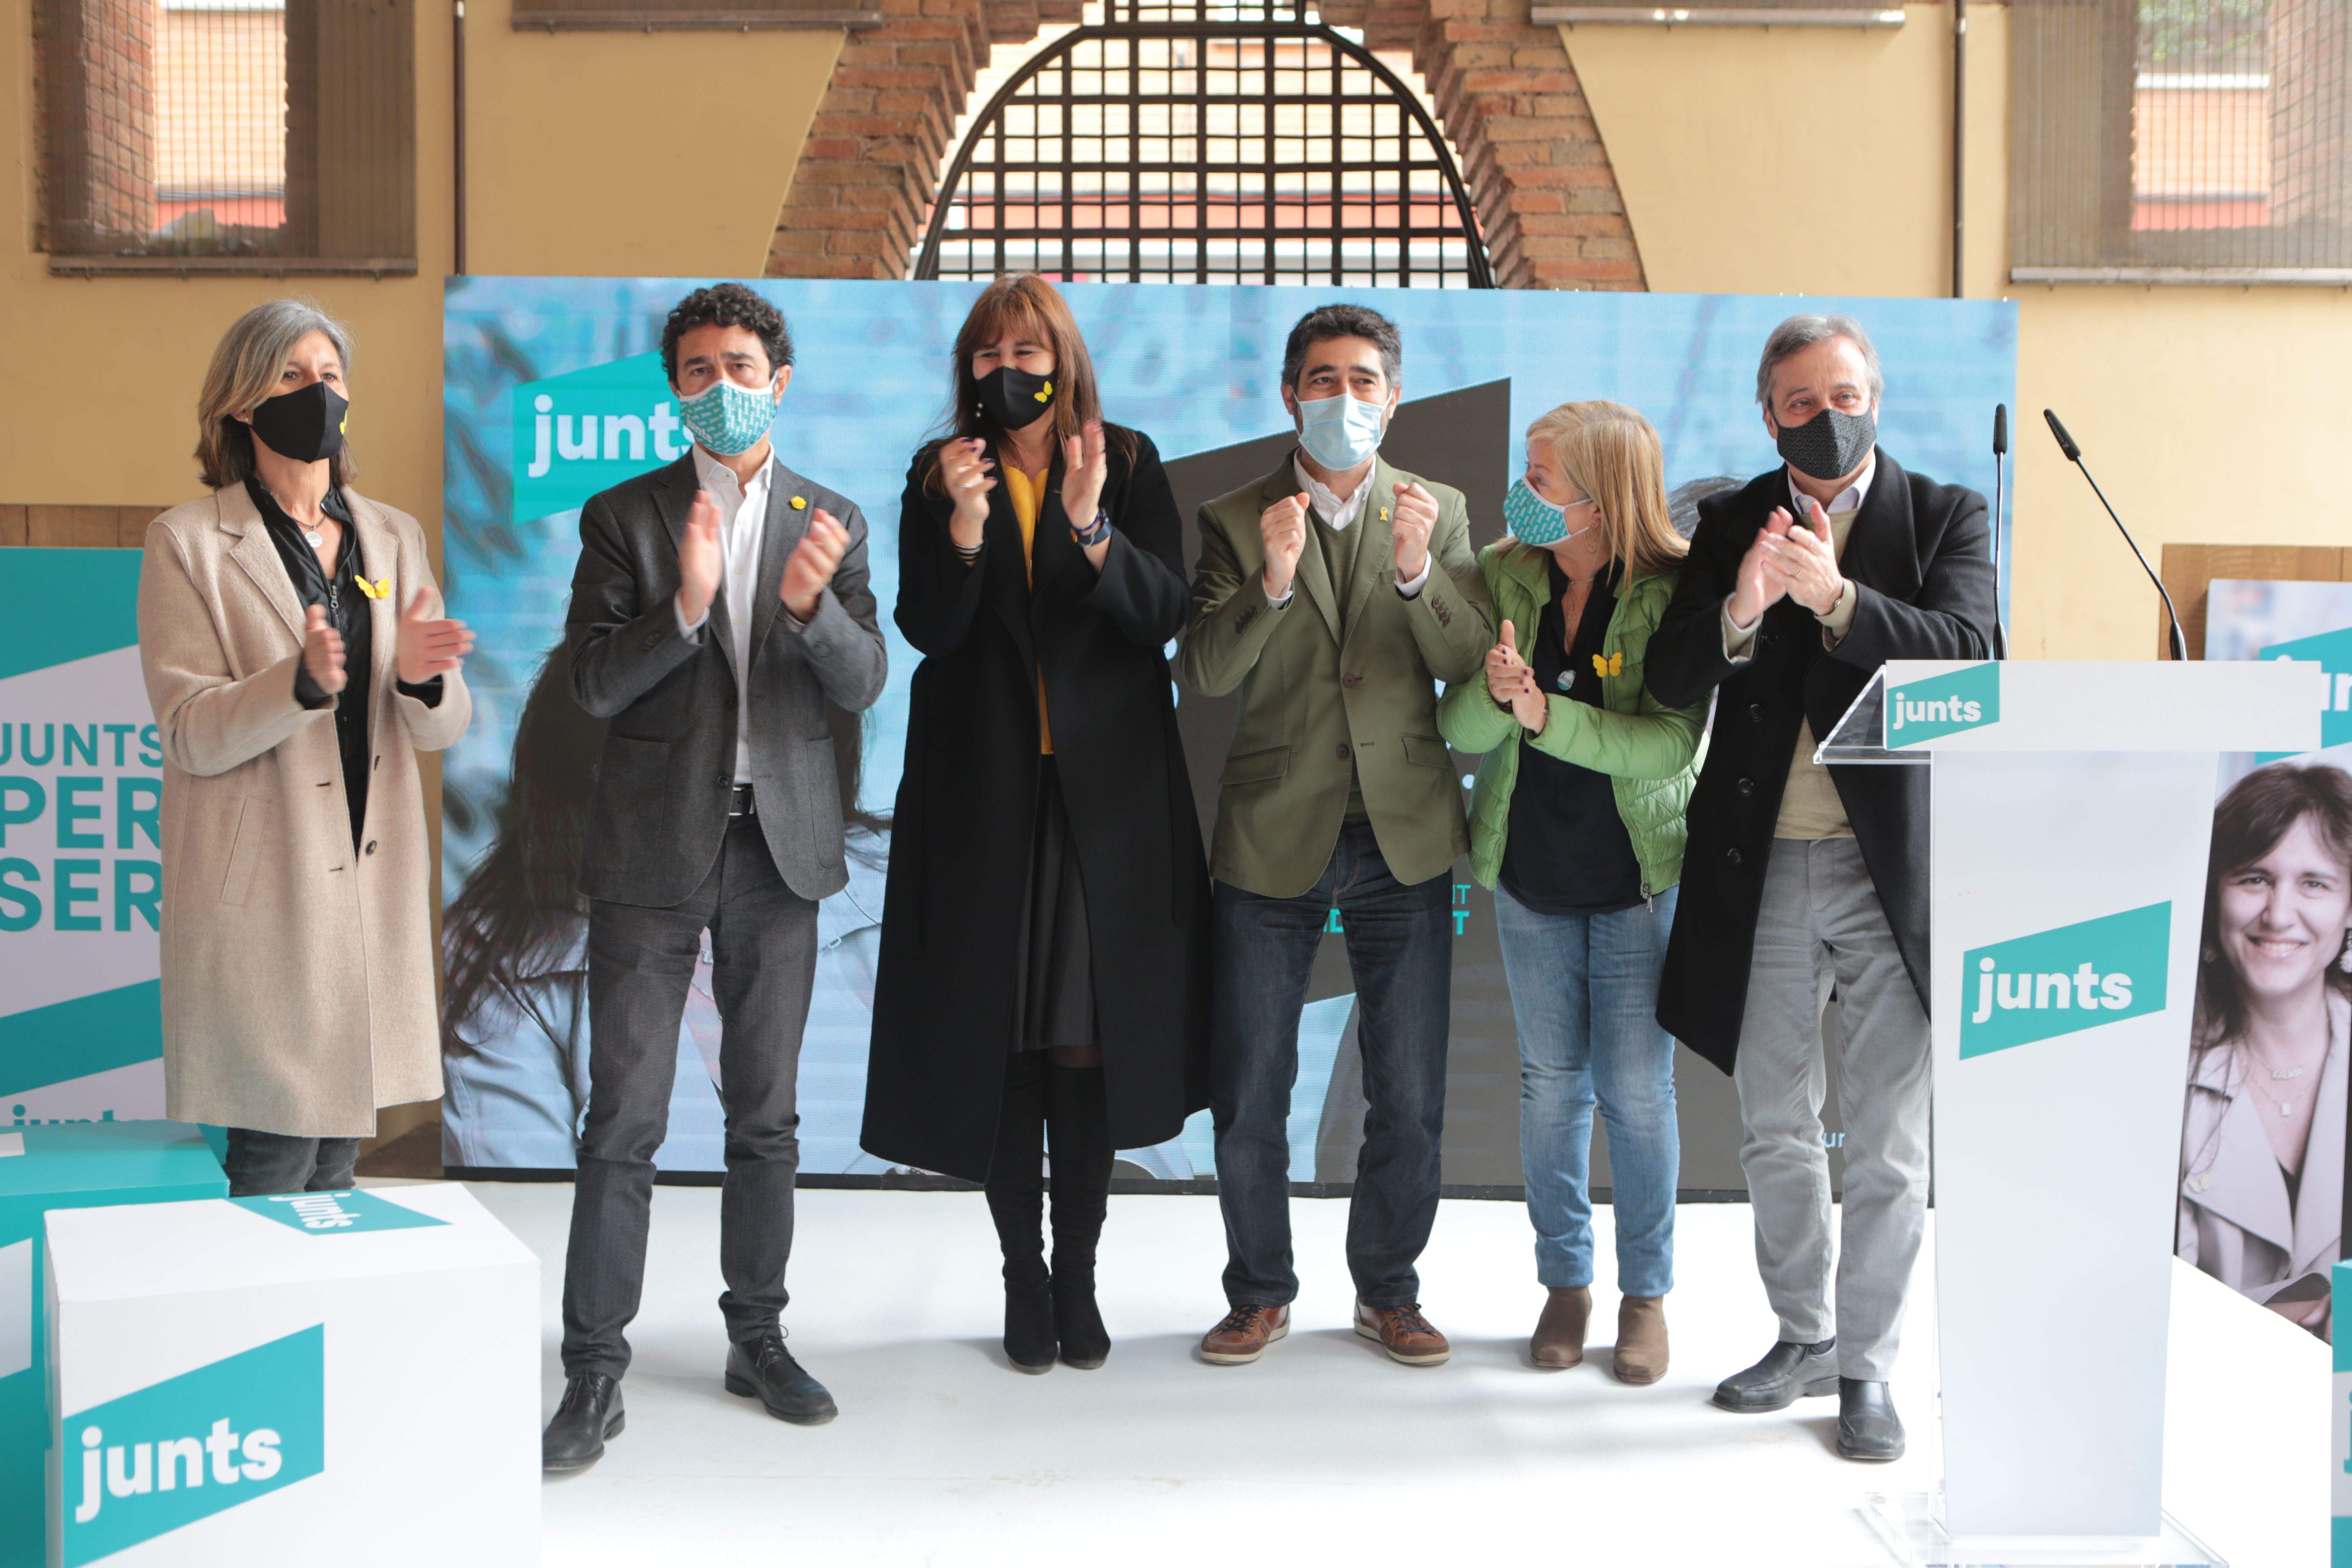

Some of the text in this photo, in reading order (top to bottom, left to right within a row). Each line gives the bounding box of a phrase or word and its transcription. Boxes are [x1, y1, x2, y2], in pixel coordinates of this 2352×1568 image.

[528, 394, 694, 478] junt
[1893, 692, 1981, 730] junts
[0, 776, 162, 849] PER
[0, 857, 162, 932] SER
[1972, 957, 2133, 1024] junts
[268, 1192, 362, 1229] junts
[76, 1417, 283, 1523] junts
